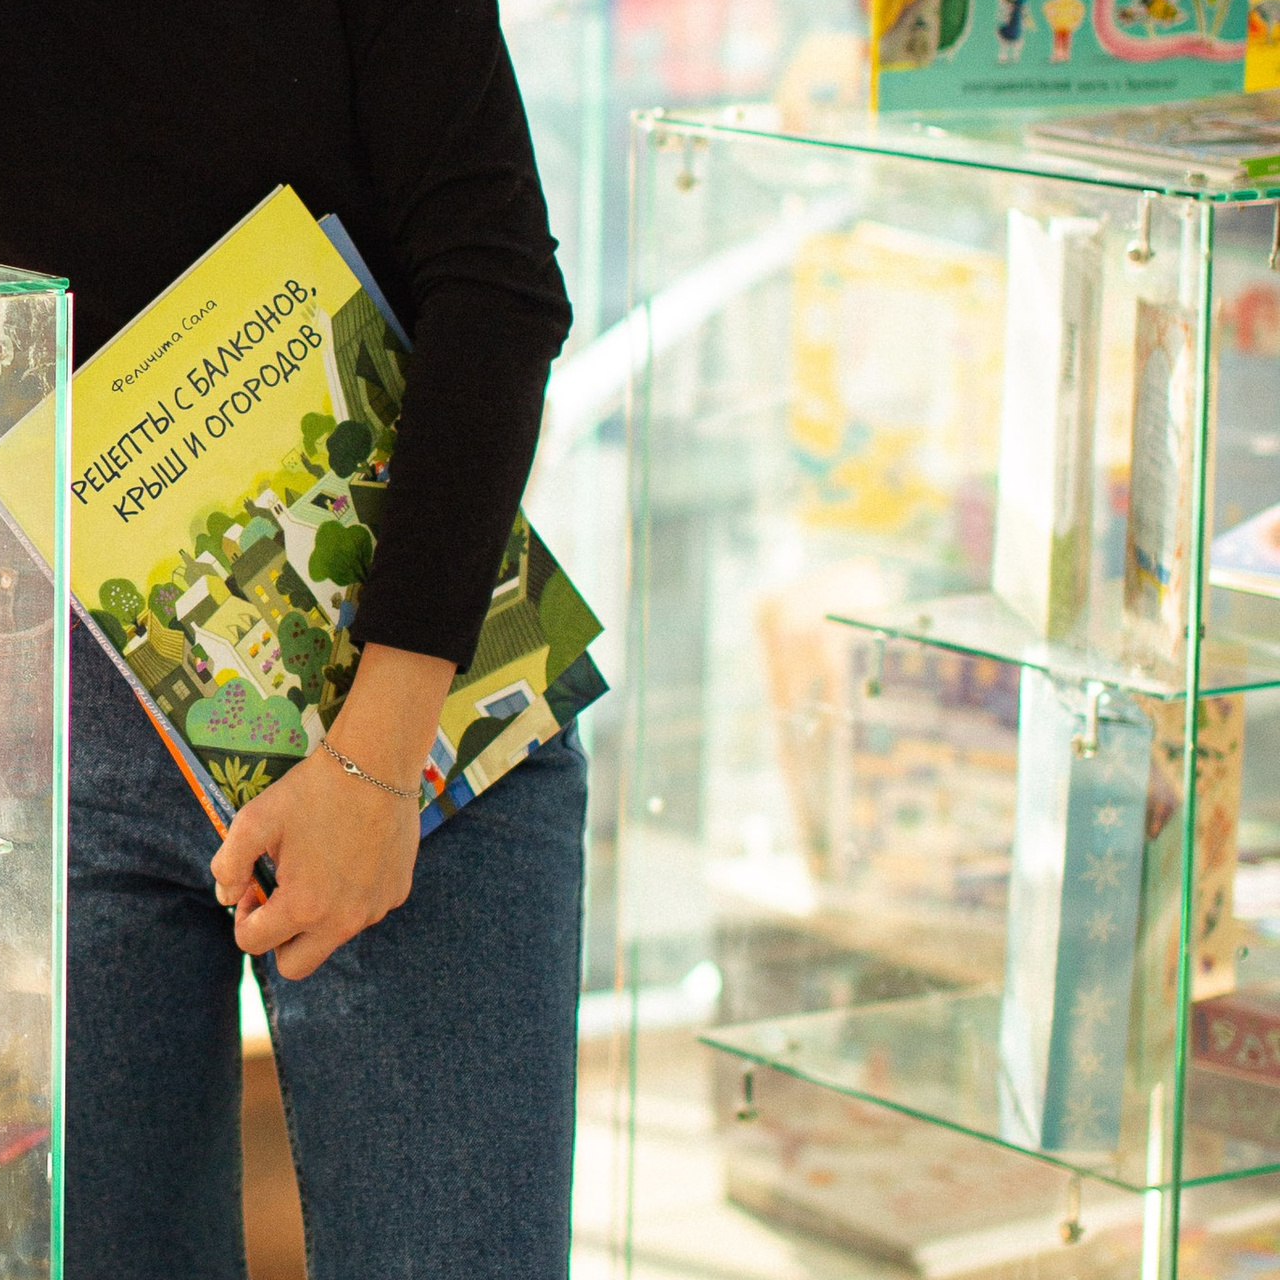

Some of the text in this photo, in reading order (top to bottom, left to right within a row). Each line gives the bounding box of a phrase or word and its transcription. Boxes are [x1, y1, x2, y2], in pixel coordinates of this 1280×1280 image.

[70, 279, 318, 505] РЕЦЕПТЫ С БАЛКОНОВ,
[111, 299, 217, 393] Феличита Сала
[113, 324, 322, 523] КРЫШ И ОГОРОДОВ
